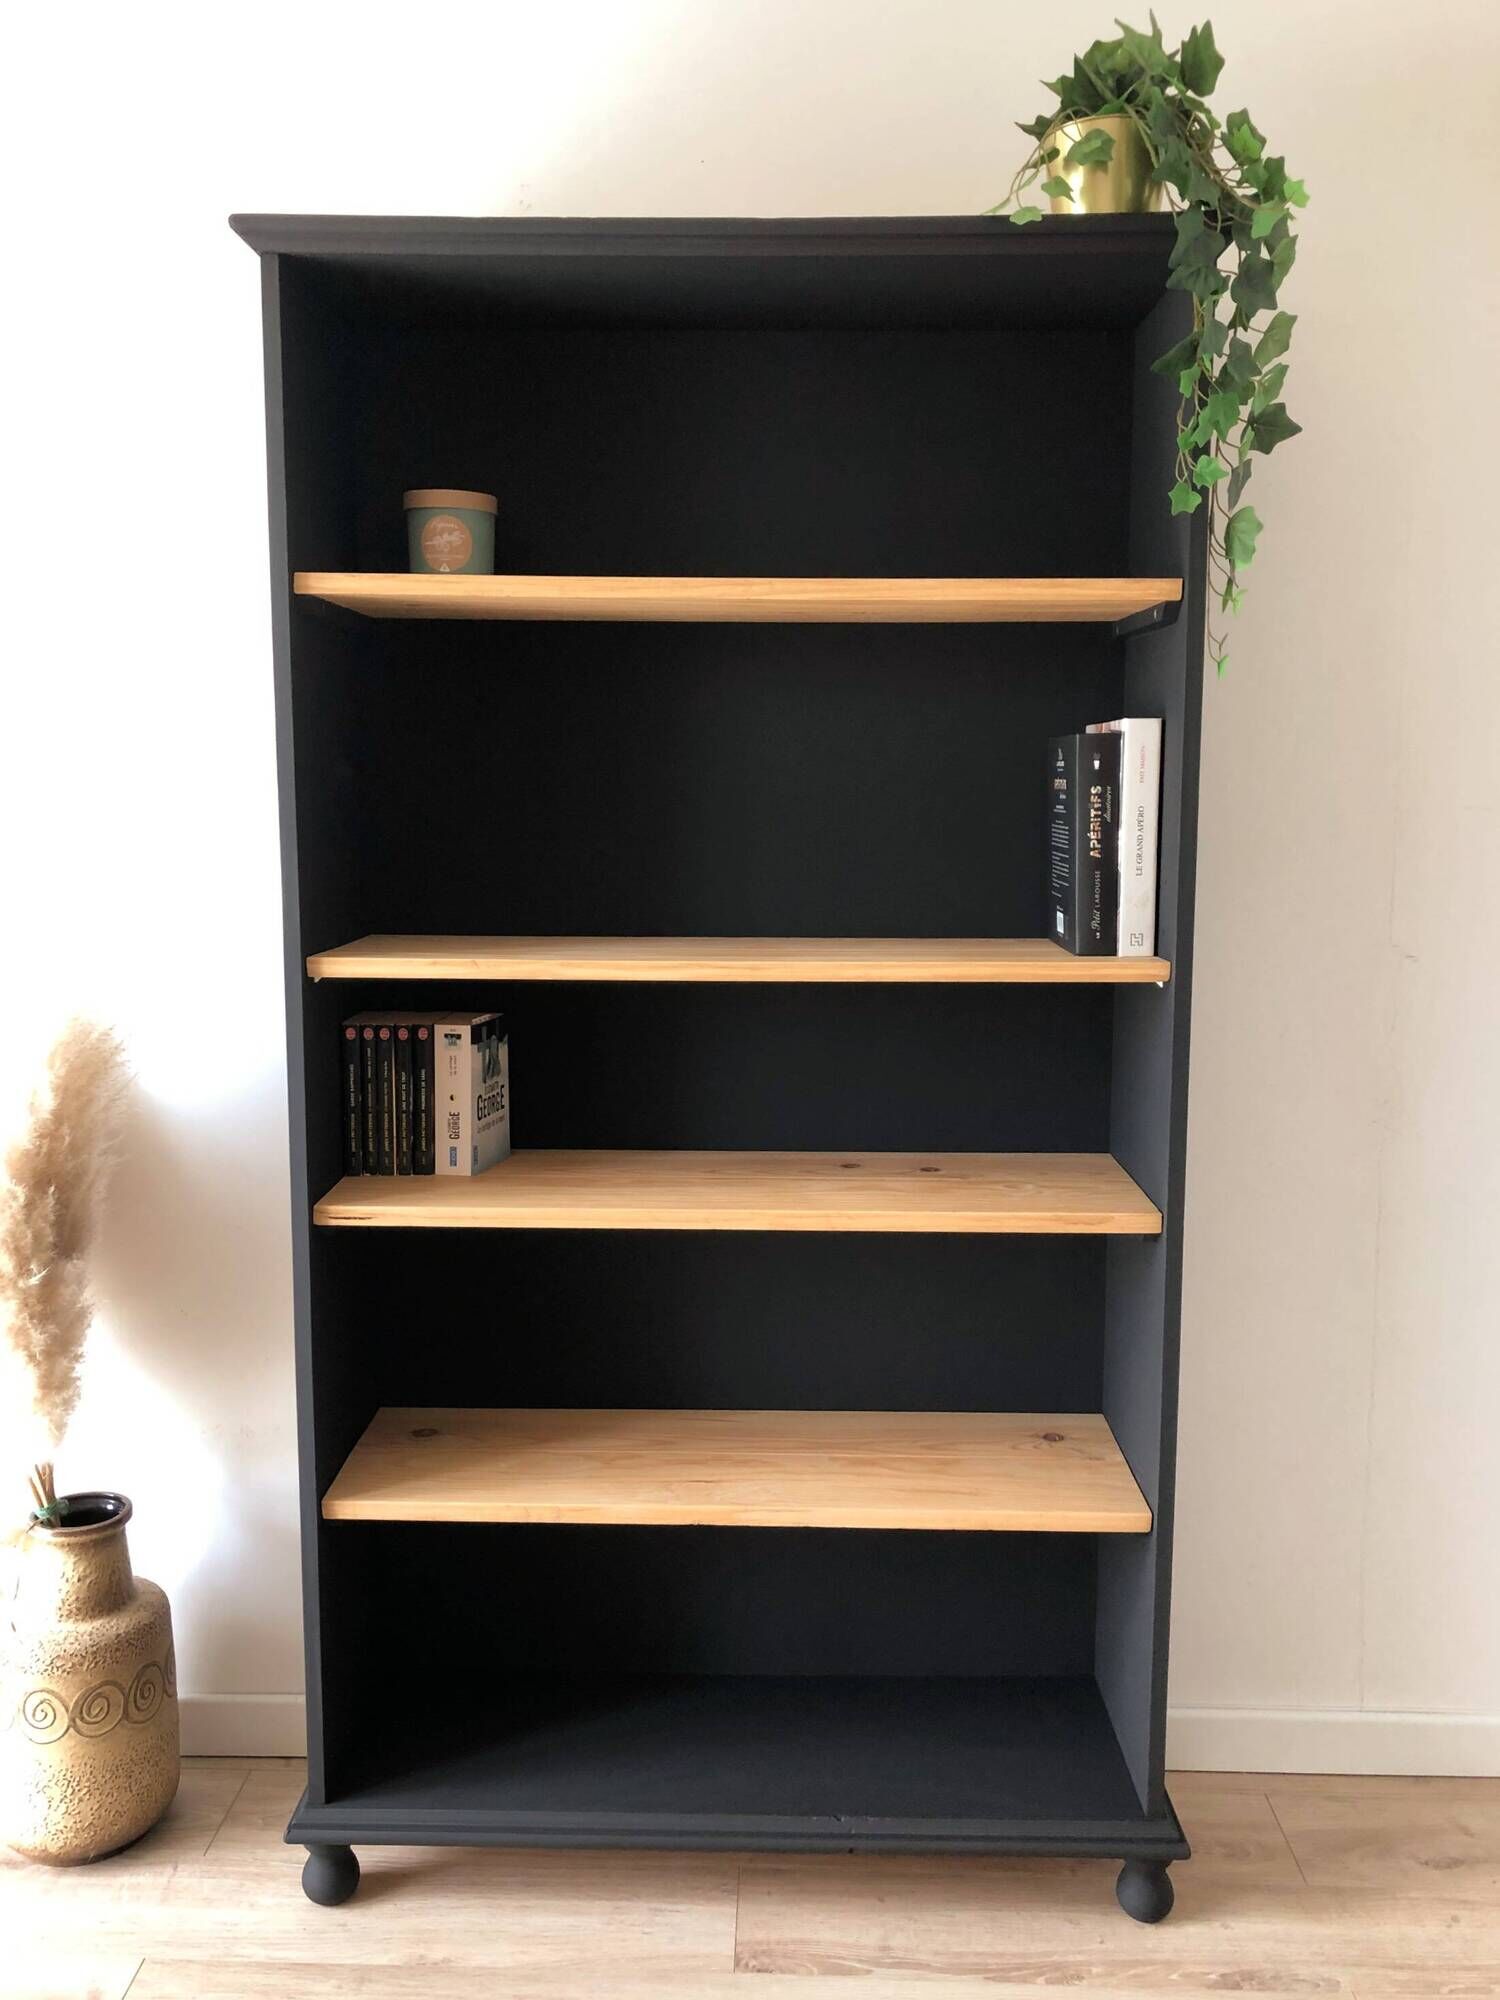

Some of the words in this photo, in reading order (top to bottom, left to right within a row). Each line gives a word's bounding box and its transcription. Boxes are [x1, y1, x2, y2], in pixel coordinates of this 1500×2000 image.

[1087, 785, 1102, 858] APÉRITIFS
[1135, 805, 1145, 834] APÉRO
[1136, 834, 1144, 864] GRAND
[1135, 865, 1143, 877] LE
[477, 1085, 505, 1121] GEORGE
[448, 1112, 460, 1140] GEORGE
